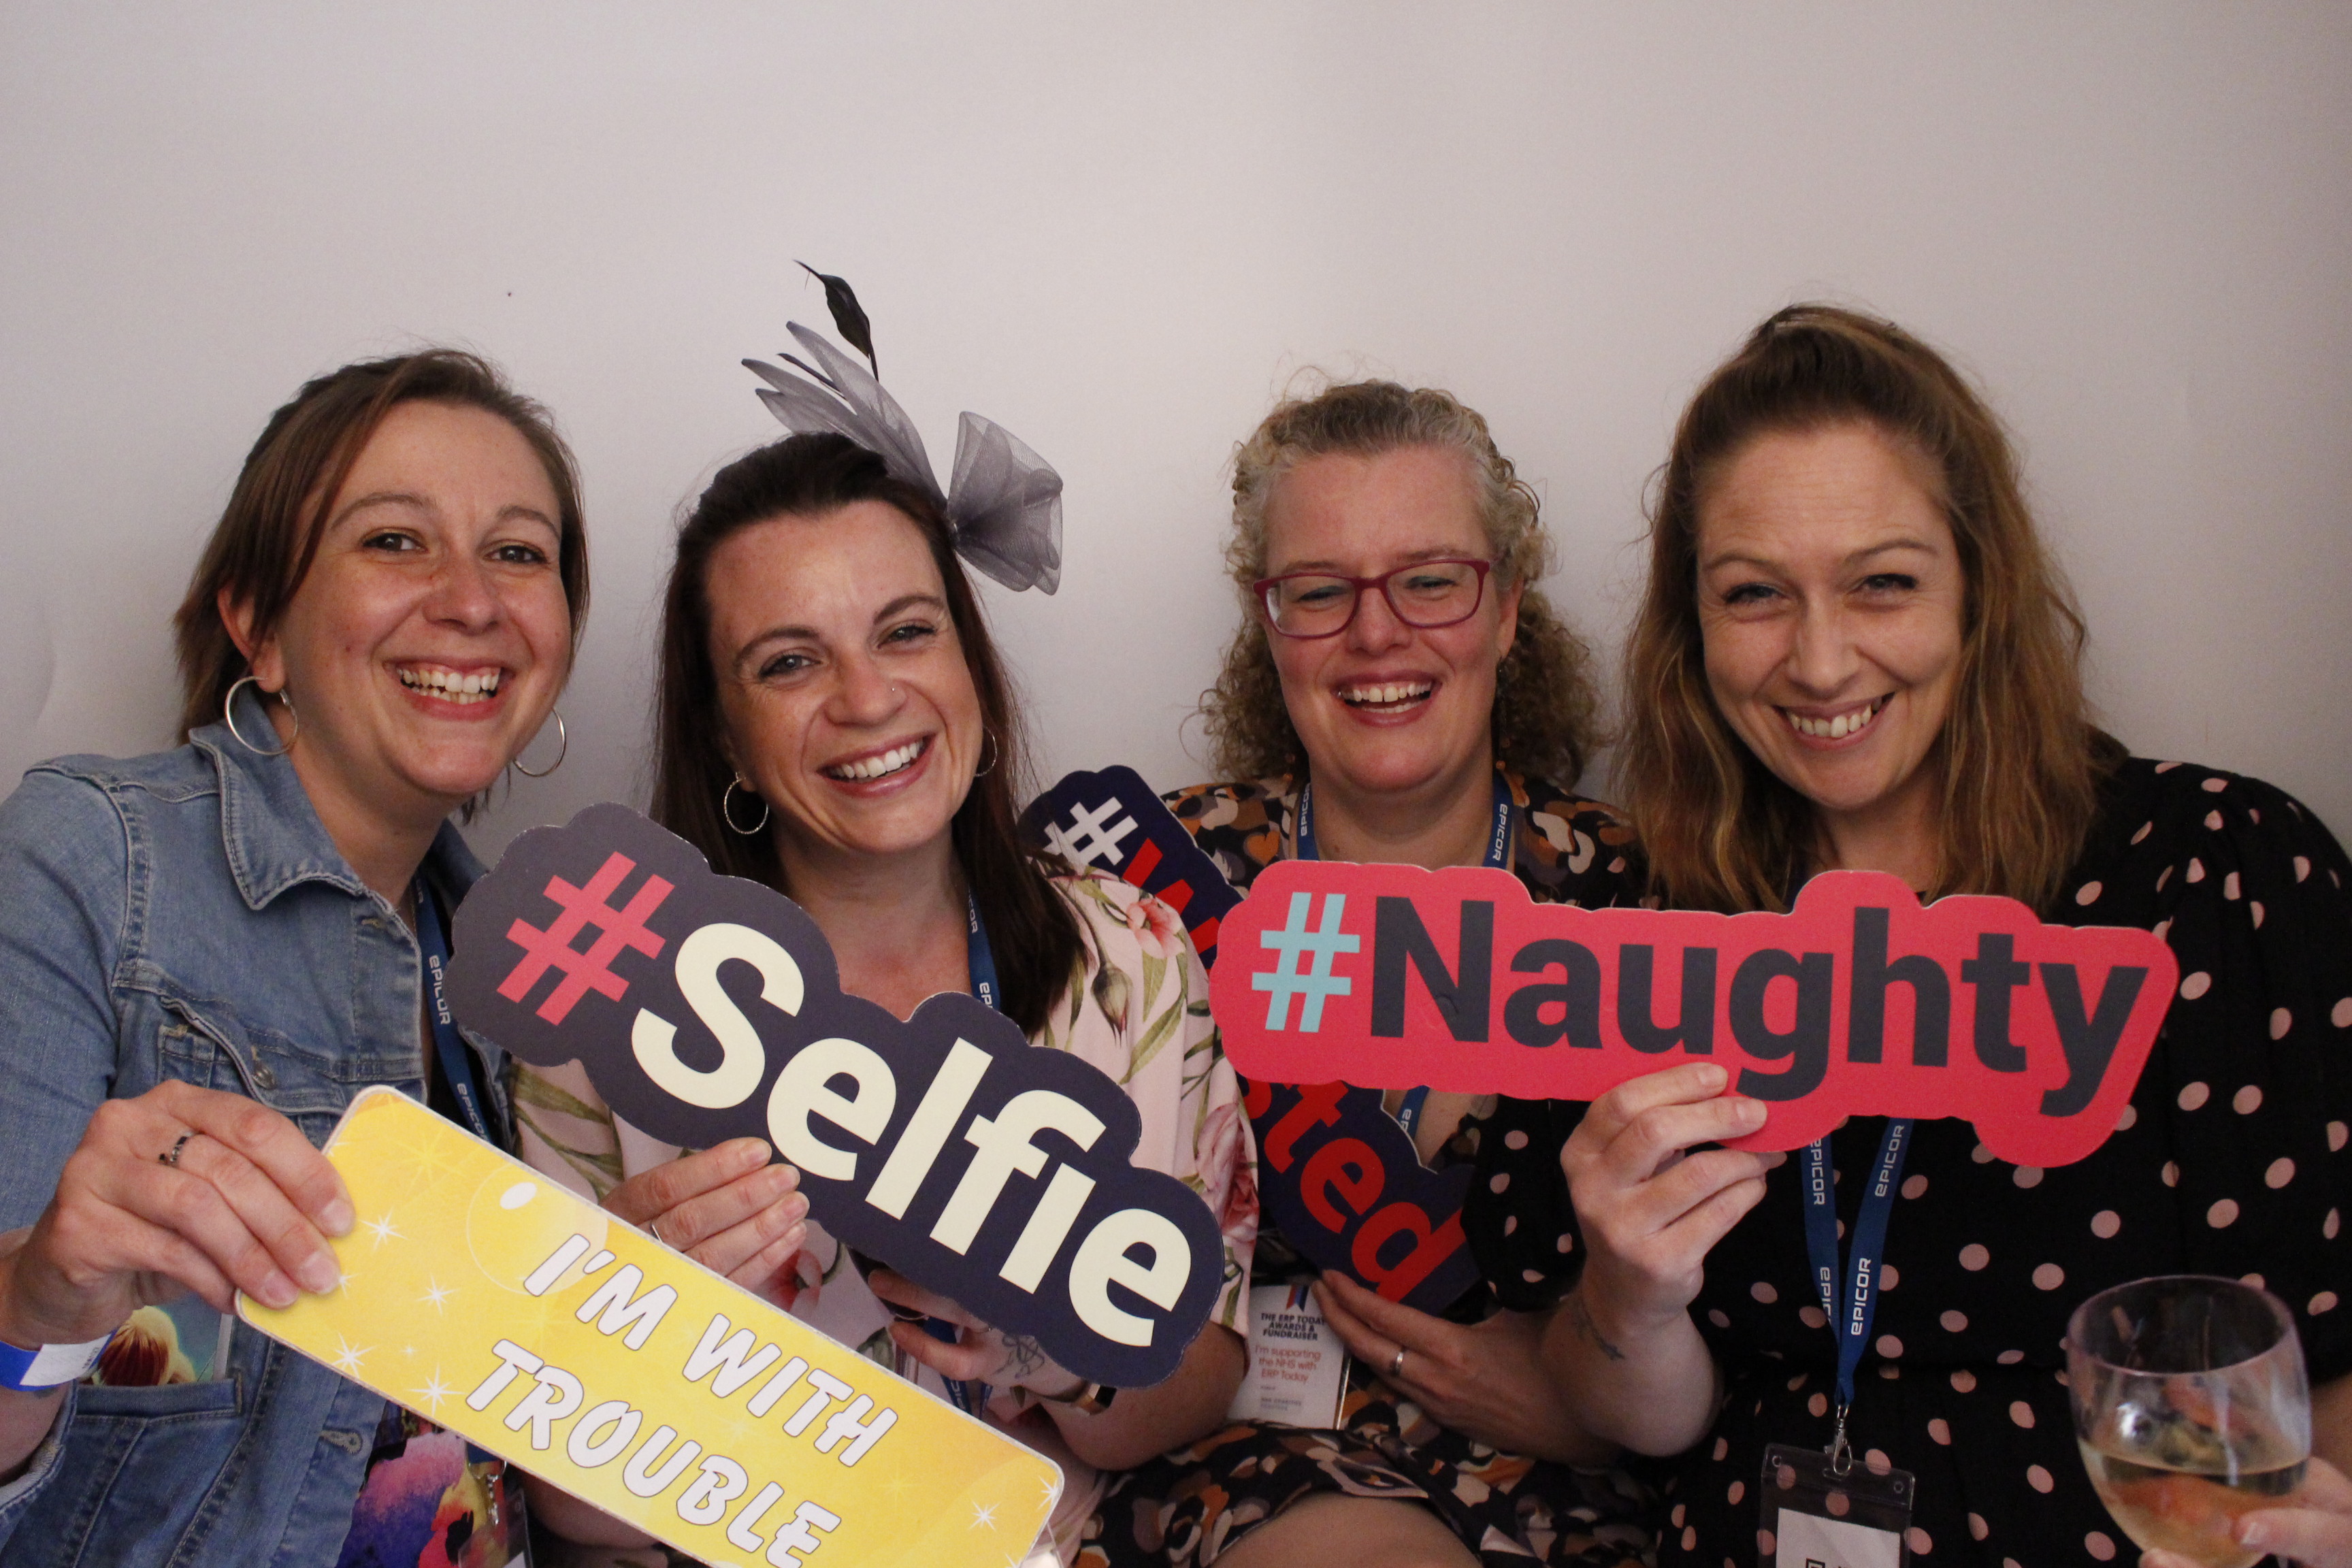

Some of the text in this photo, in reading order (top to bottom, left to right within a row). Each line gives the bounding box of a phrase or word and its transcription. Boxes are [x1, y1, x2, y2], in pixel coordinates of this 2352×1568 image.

[1252, 892, 2149, 1117] #Naughty
[496, 851, 1192, 1347] #Selfie
[1261, 1313, 1277, 1321] THE
[1279, 1314, 1295, 1322] ERP
[1262, 1328, 1318, 1341] FUNDRAISER
[1269, 1322, 1307, 1332] AWARDS
[523, 1233, 899, 1467] I'M WITH
[1271, 1348, 1322, 1362] supporting
[1258, 1357, 1274, 1367] the
[1298, 1361, 1317, 1371] with
[1261, 1368, 1309, 1385] ERP Today
[466, 1339, 842, 1568] TROUBLE
